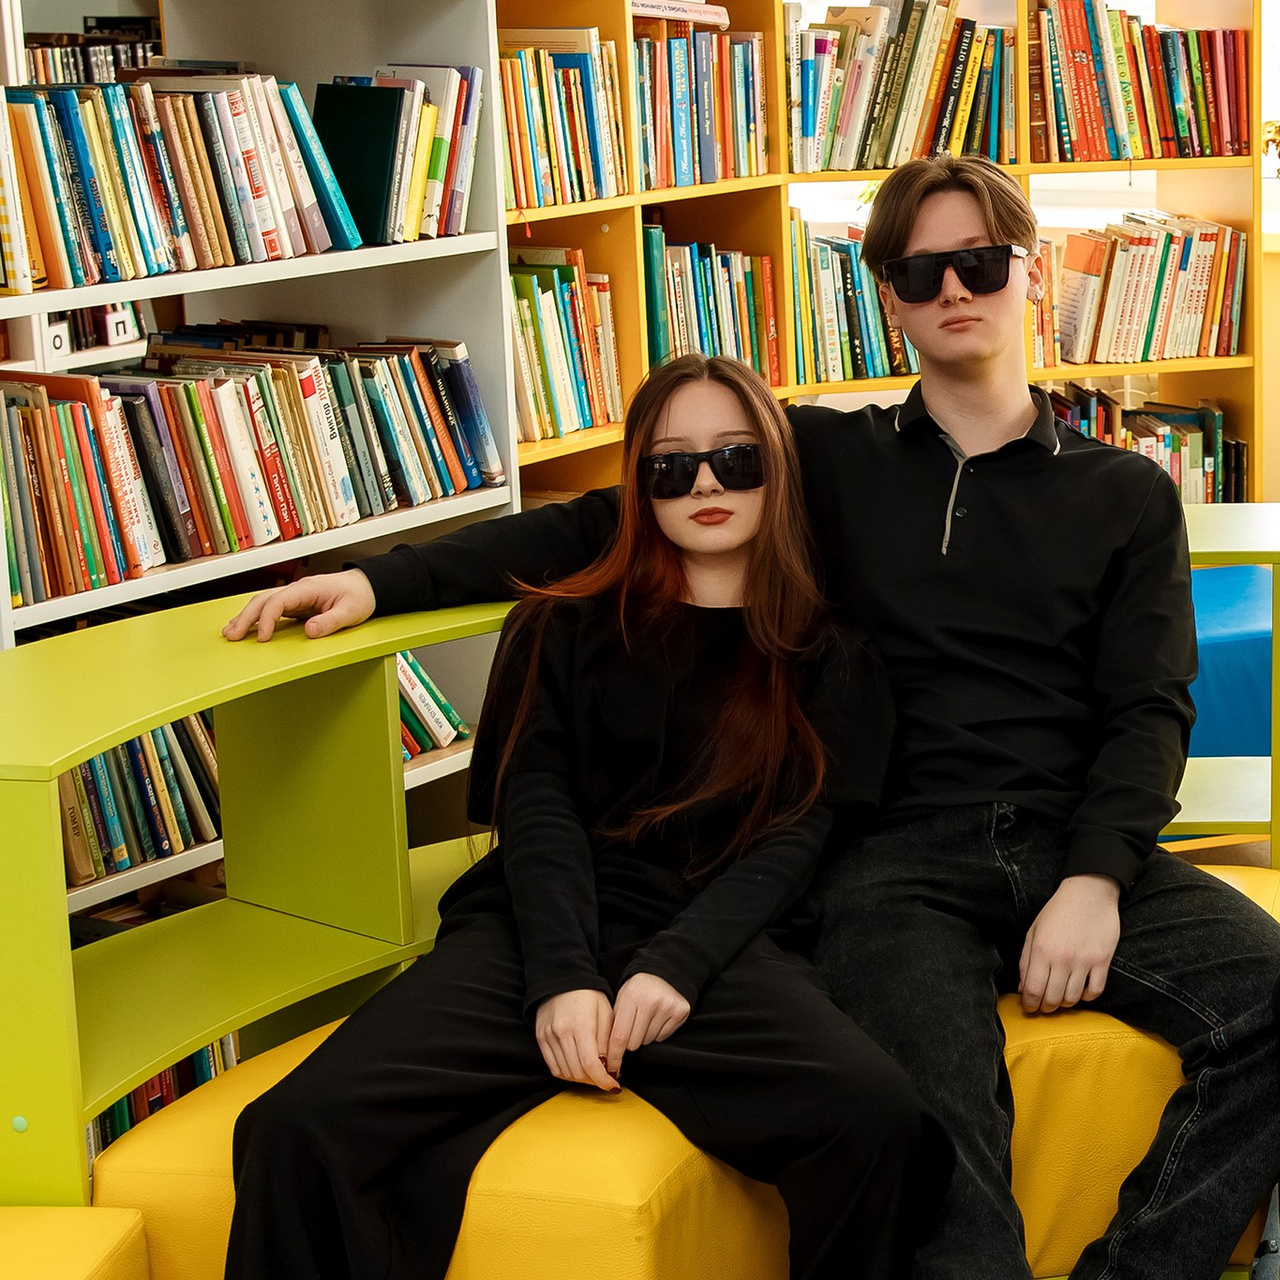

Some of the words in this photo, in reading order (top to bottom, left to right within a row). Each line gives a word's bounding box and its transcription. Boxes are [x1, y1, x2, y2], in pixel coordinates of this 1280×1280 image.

[674, 41, 682, 99] НЕЗНАЙКА
[951, 64, 963, 89] СЕМЬ
[958, 30, 972, 61] ОГНЕЙ
[936, 127, 947, 153] Борис
[942, 95, 955, 127] Житков
[1128, 253, 1137, 278] УРОКОВ
[1137, 253, 1145, 277] УРОКОВ
[115, 321, 126, 336] П
[312, 366, 325, 401] ЛУНИН
[437, 379, 456, 426] ХРАНИТЕЛИ
[323, 403, 337, 440] Виктор
[123, 432, 141, 480] Приключения
[272, 473, 283, 502] ПИТЕР
[280, 503, 290, 523] ПЭН
[68, 806, 81, 837] ГОМЕР
